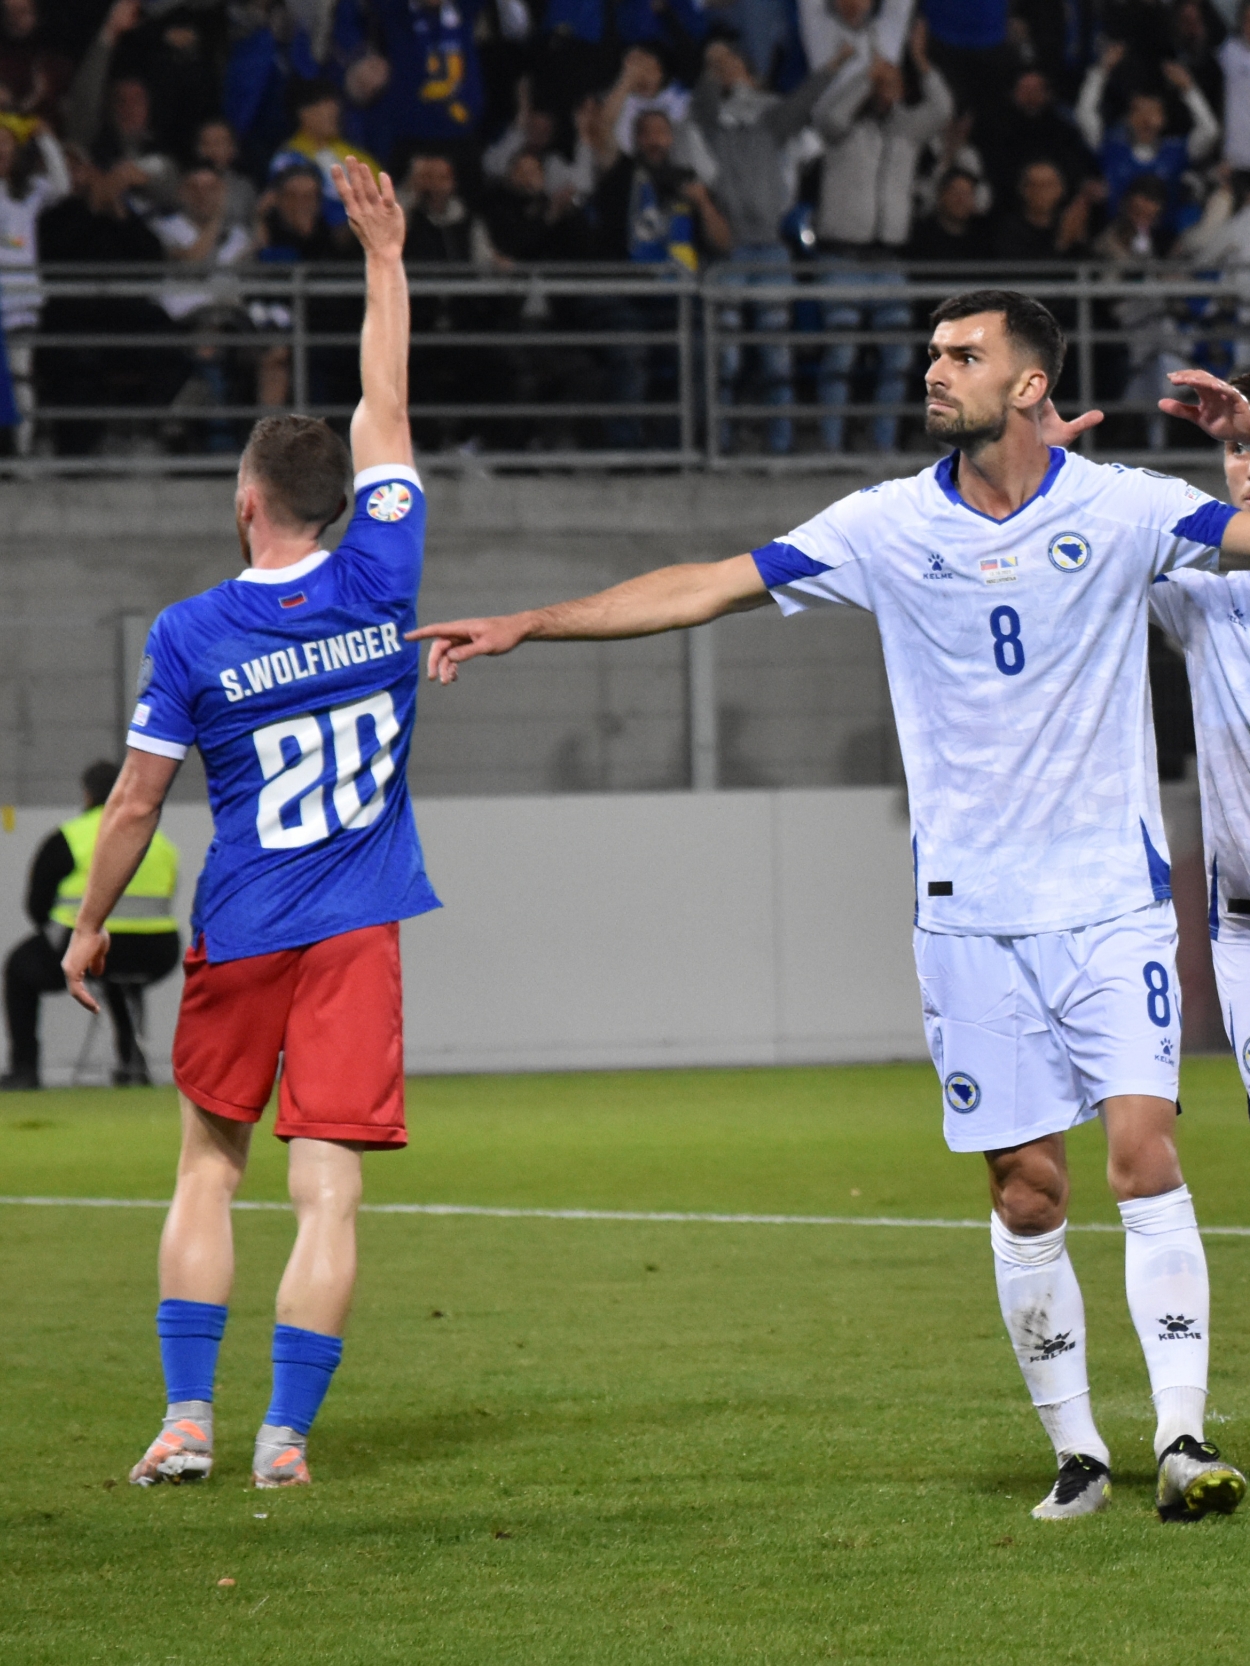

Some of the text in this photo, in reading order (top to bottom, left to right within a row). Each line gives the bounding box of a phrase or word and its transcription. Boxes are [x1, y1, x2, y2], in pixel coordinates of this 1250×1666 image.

[219, 621, 402, 702] S.WOLFINGER
[989, 604, 1026, 677] 8
[252, 689, 401, 849] 20
[1142, 960, 1171, 1028] 8
